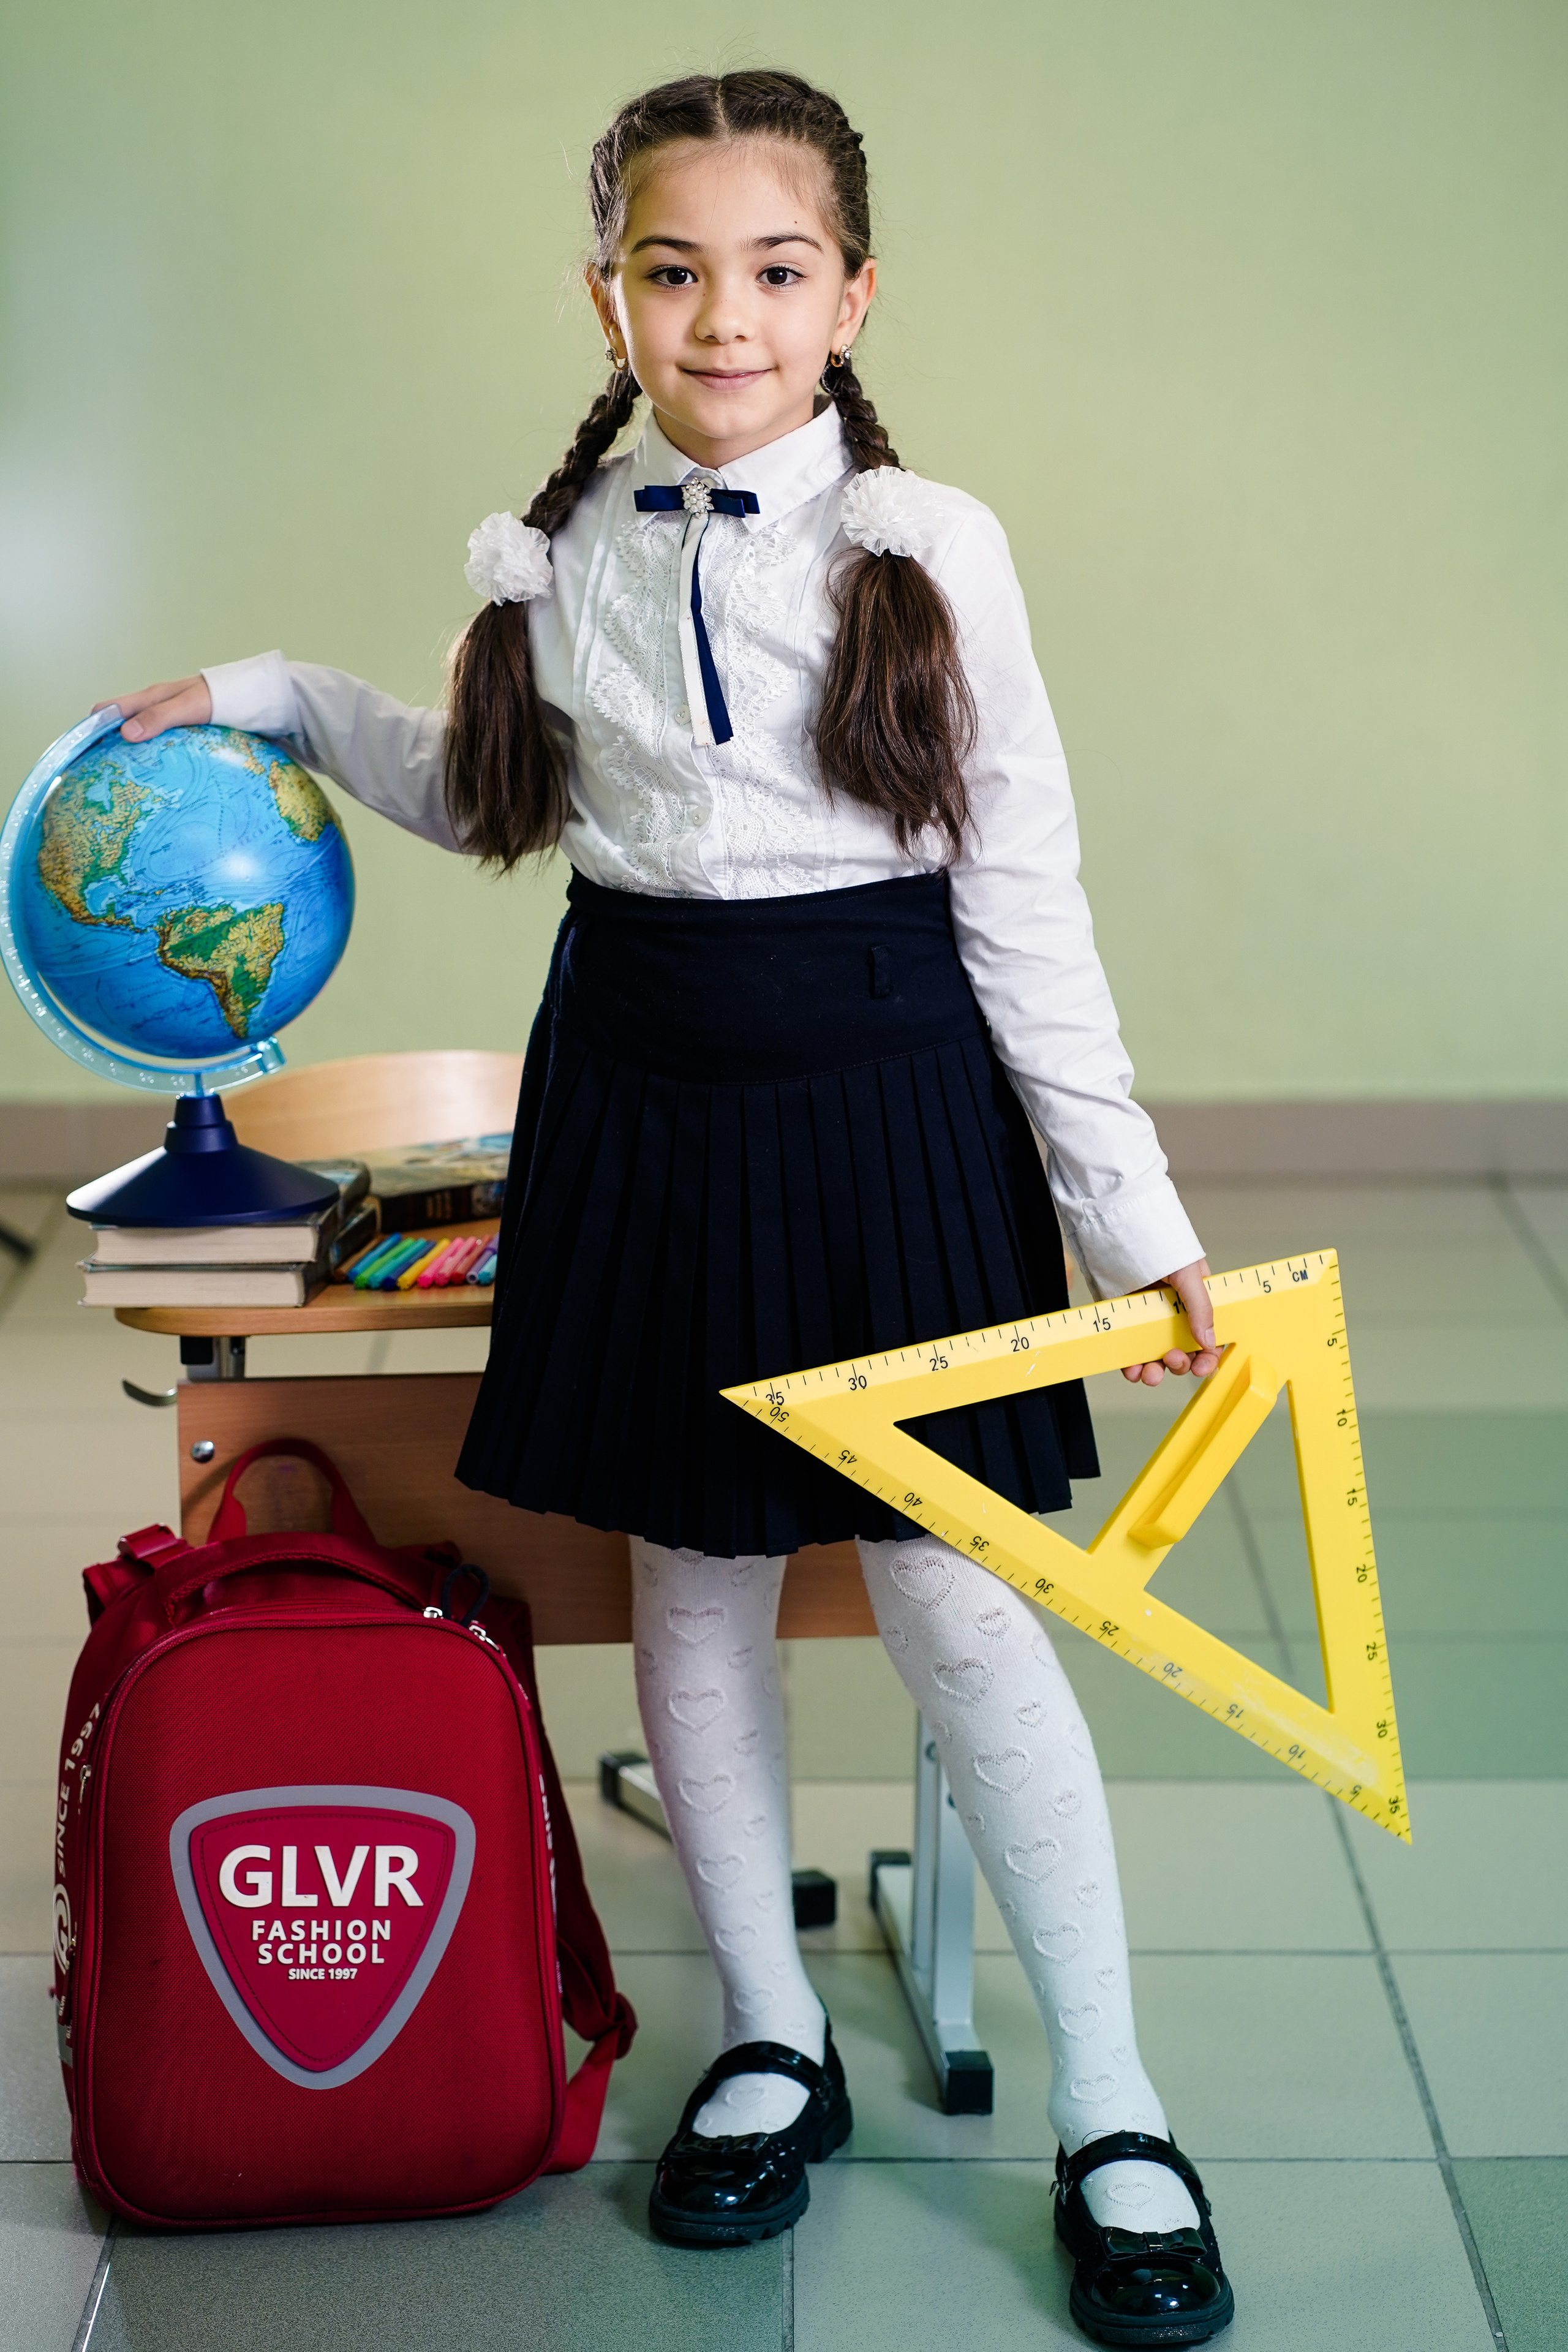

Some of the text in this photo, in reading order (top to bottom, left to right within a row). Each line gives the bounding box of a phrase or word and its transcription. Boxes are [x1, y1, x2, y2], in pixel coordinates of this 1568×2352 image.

[1290, 1269, 1308, 1283] CM
[1263, 1281, 1272, 1293] 5
[1093, 1315, 1111, 1332] 15
[1011, 1336, 1030, 1352] 20
[1327, 1338, 1337, 1347] 5
[929, 1355, 948, 1371] 25
[848, 1375, 867, 1391] 30
[766, 1391, 785, 1406] 35
[770, 1406, 790, 1423] 50
[1336, 1409, 1348, 1427] 10
[838, 1450, 858, 1464] 45
[903, 1492, 923, 1507] 40
[1347, 1488, 1357, 1506] 15
[970, 1536, 990, 1551] 35
[1356, 1564, 1367, 1583] 20
[1035, 1578, 1054, 1594] 30
[1099, 1621, 1120, 1636] 25
[1366, 1642, 1378, 1660] 25
[1163, 1662, 1183, 1678] 20
[1226, 1704, 1245, 1719] 15
[1376, 1719, 1388, 1738] 30
[1288, 1744, 1306, 1758] 10
[56, 1702, 100, 1878] SINCE 1997
[1351, 1785, 1362, 1795] 5
[1389, 1795, 1400, 1814] 35
[219, 1844, 424, 1908] GLVR
[252, 1919, 391, 1941] FASHION
[257, 1943, 386, 1965] SCHOOL
[288, 1967, 358, 1980] SINCE 1997
